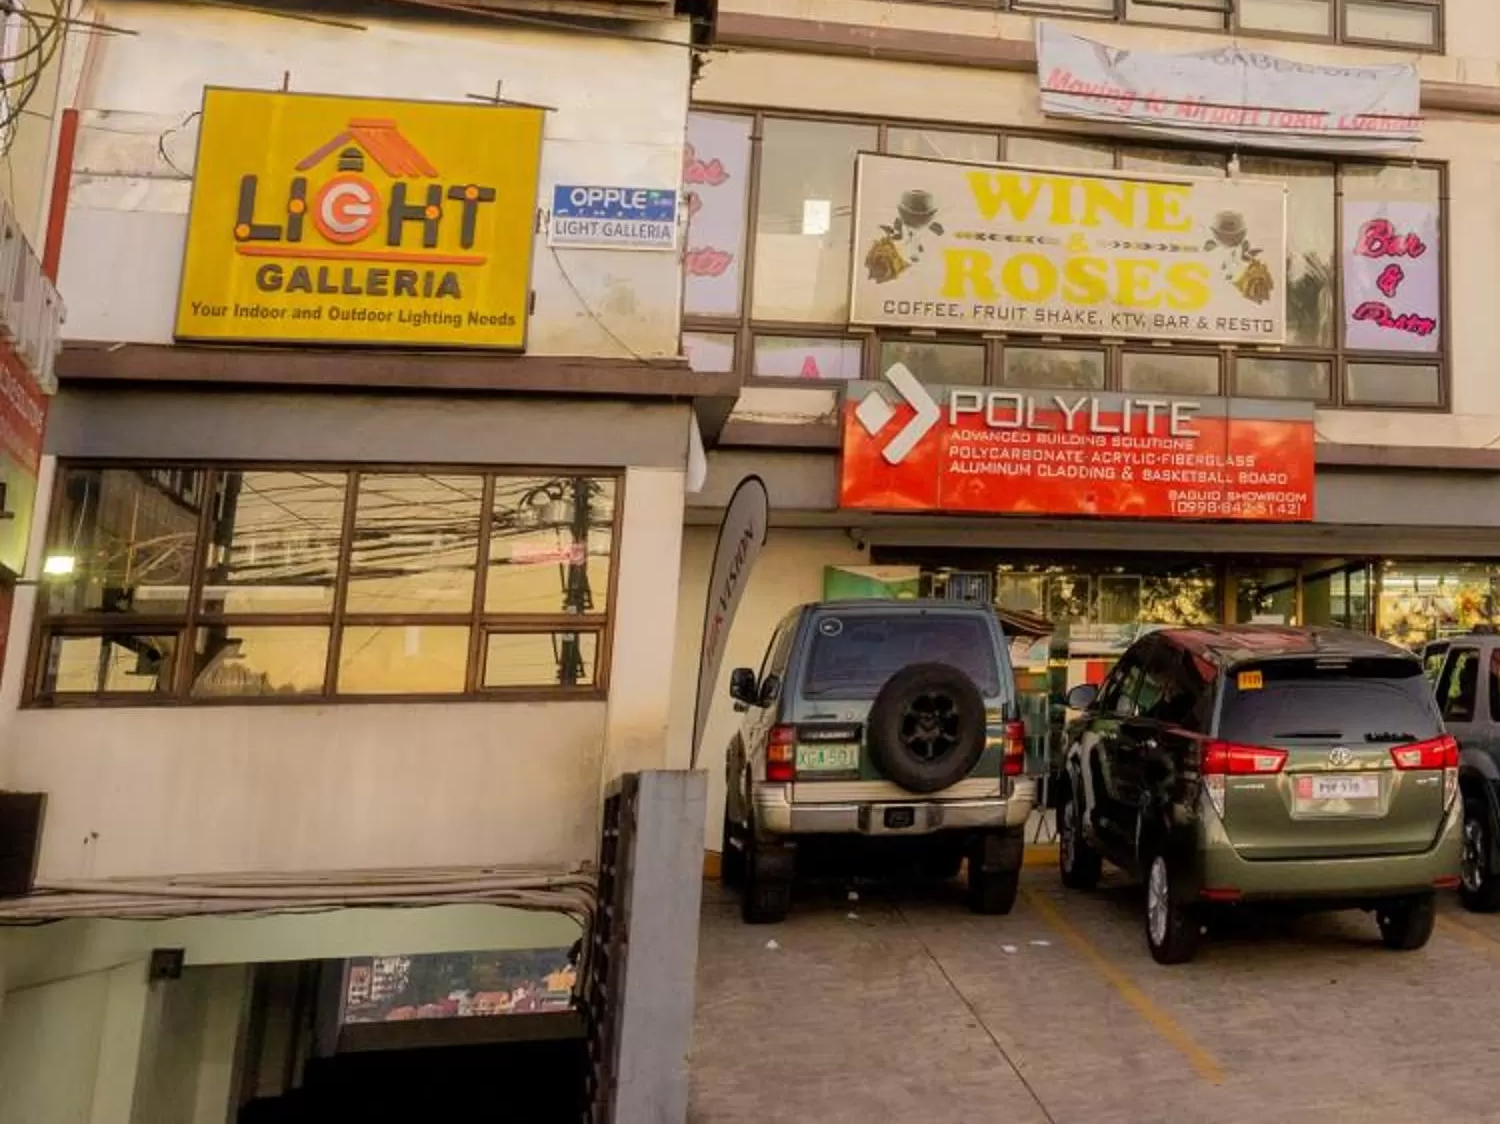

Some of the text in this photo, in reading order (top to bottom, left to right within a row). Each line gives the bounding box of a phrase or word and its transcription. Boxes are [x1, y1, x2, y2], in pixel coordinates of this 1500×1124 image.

[234, 171, 497, 250] LIGHT
[570, 187, 648, 209] OPPLE
[963, 170, 1193, 233] WINE
[554, 220, 672, 240] LIGHT GALLERIA
[1062, 232, 1089, 252] &
[1354, 217, 1427, 259] Bar
[255, 264, 463, 300] GALLERIA
[940, 248, 1211, 311] ROSES
[190, 301, 516, 328] Your Indoor and Outdoor Lighting Needs
[882, 300, 1274, 333] COFFEE, FRUIT SHAKE, KTV, BAR & RESTO
[948, 389, 1201, 438] POLYLITE
[950, 430, 1195, 451] ADVANCED BUILDING SOLUTIONS
[949, 461, 1288, 485] ALUMINUM CLADDING & BASKETBALL BOARD
[1168, 489, 1307, 503] BAGUIO SHOWROOM
